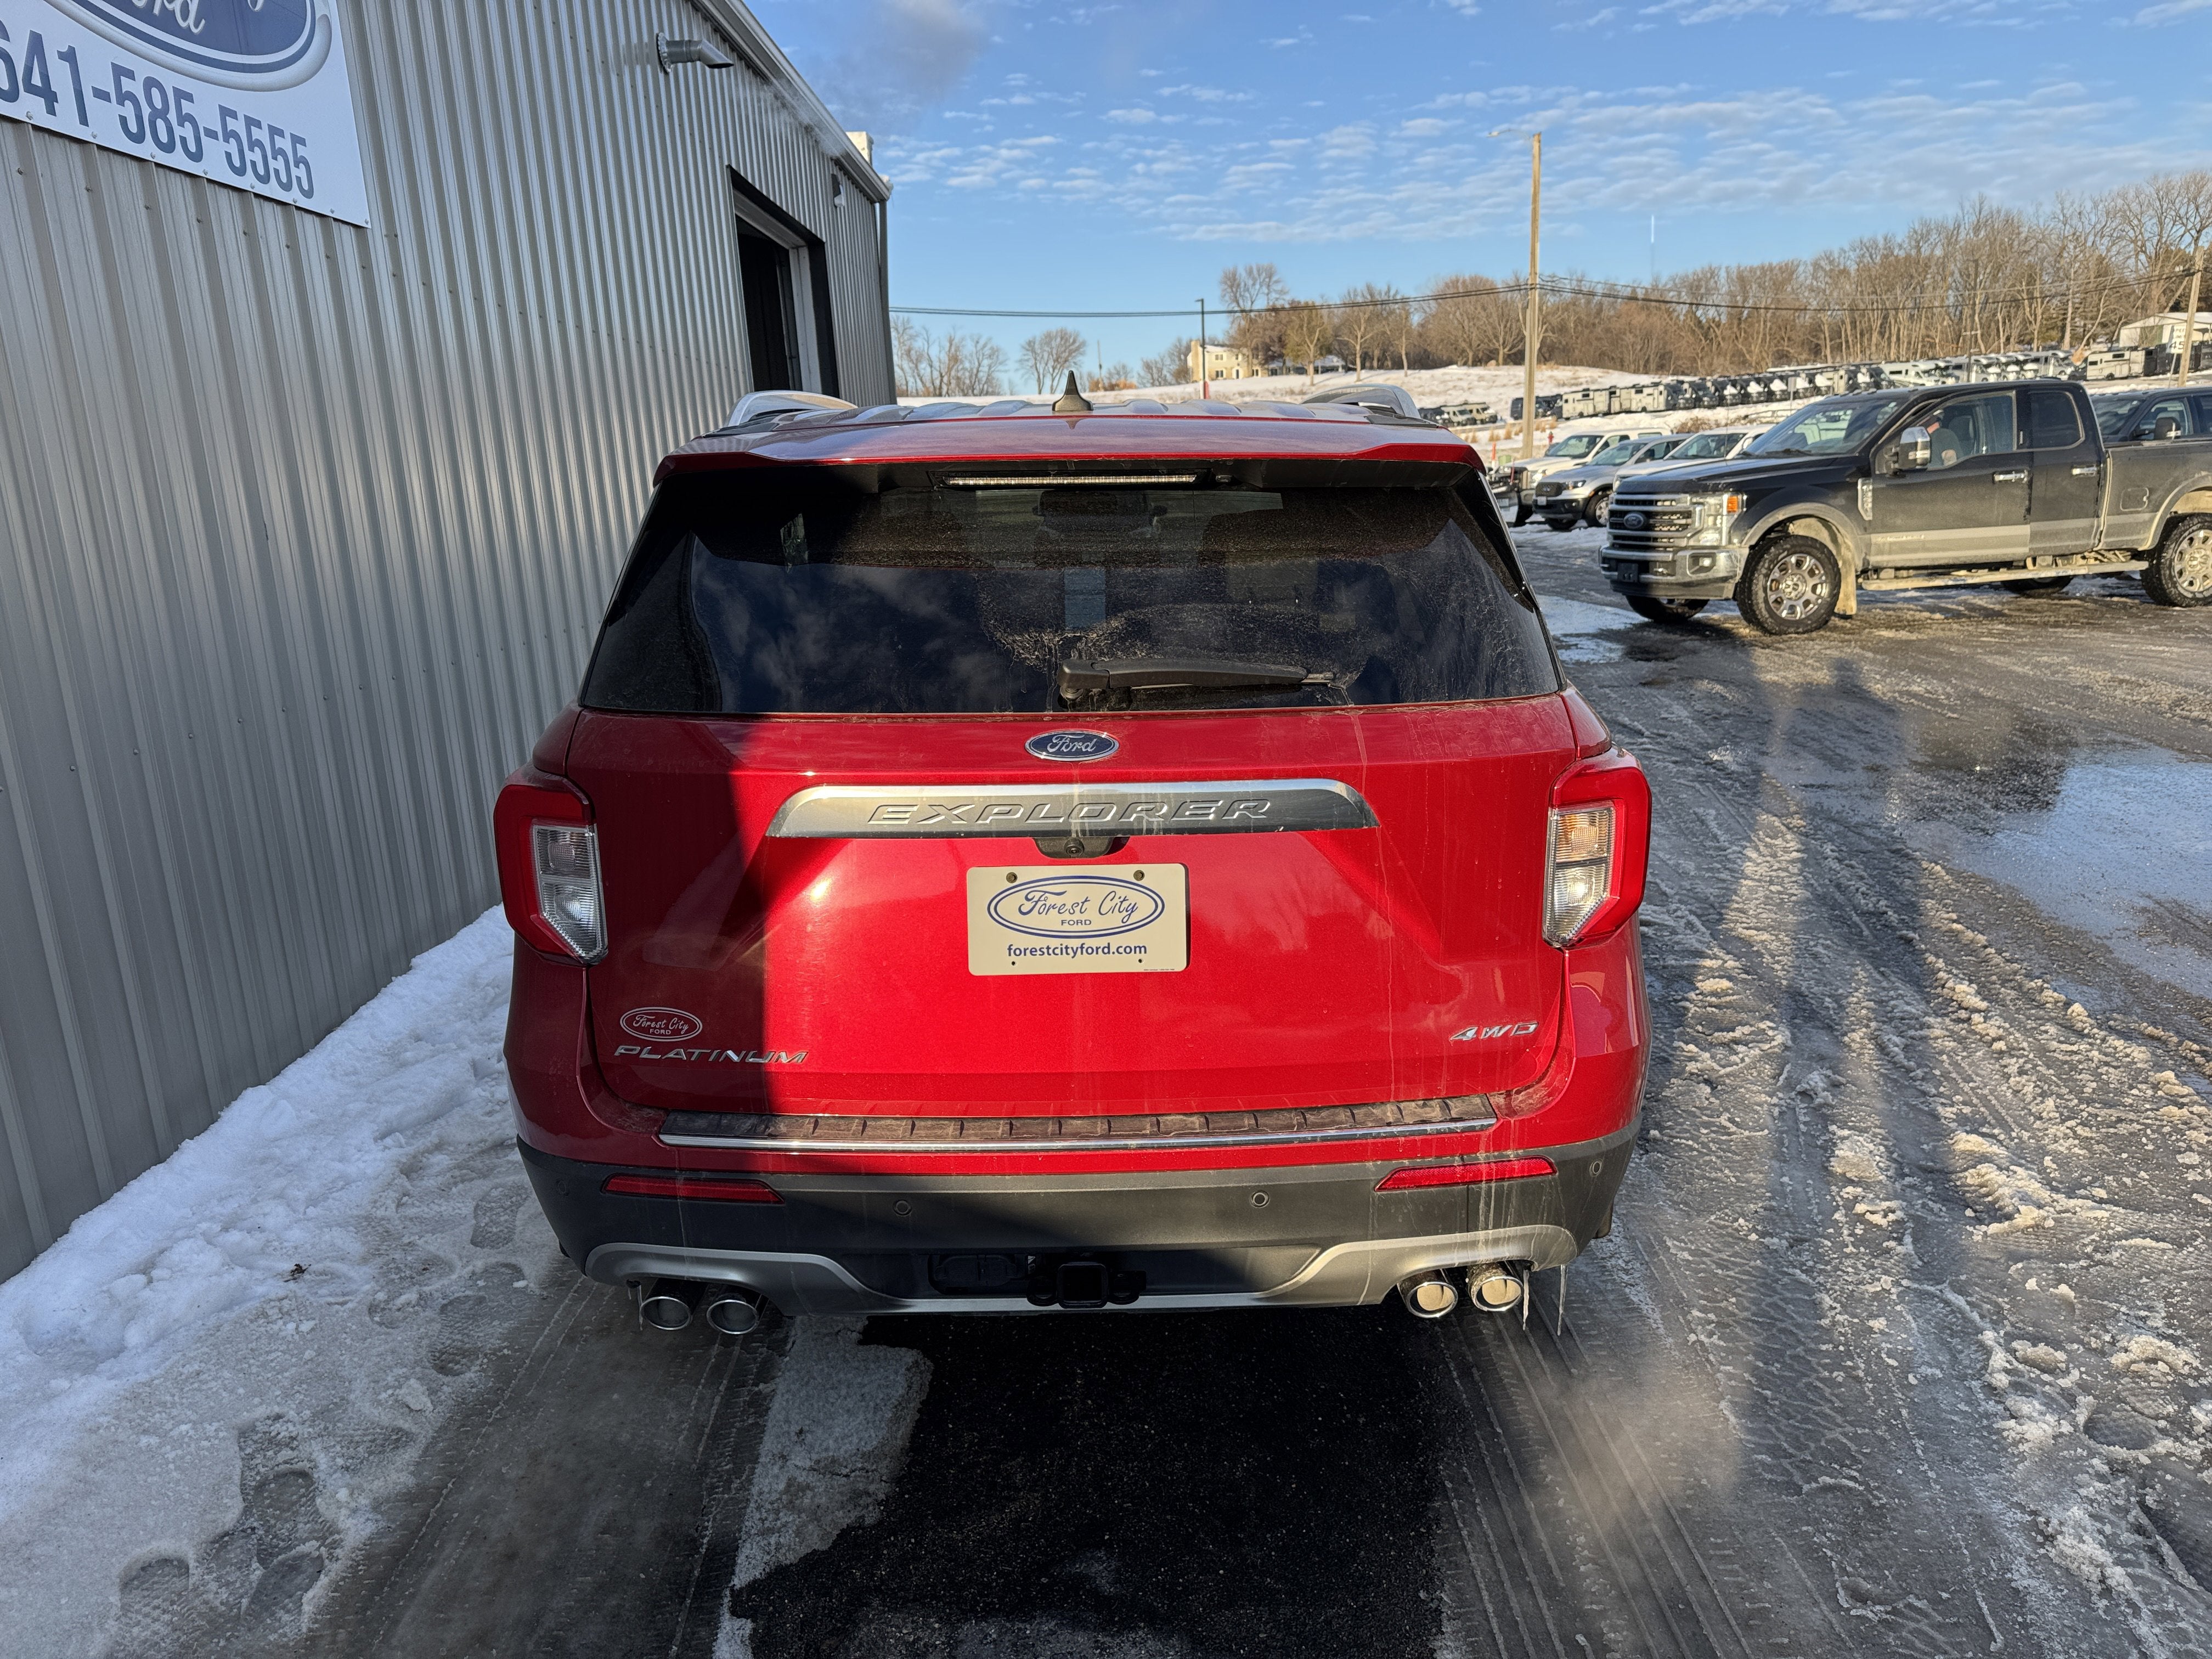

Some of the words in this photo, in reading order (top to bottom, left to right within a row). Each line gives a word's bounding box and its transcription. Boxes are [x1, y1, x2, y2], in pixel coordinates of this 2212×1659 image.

[2169, 341, 2185, 349] 45
[1047, 734, 1097, 753] Ford
[867, 799, 1271, 824] EXPLORER
[1018, 890, 1091, 916] Forest
[1098, 890, 1138, 924] City
[1007, 943, 1147, 958] forestcityford.com
[633, 1014, 667, 1028] Forest
[669, 1017, 689, 1035] City
[1449, 1020, 1539, 1041] 4WD
[614, 1045, 809, 1064] PLATINUM
